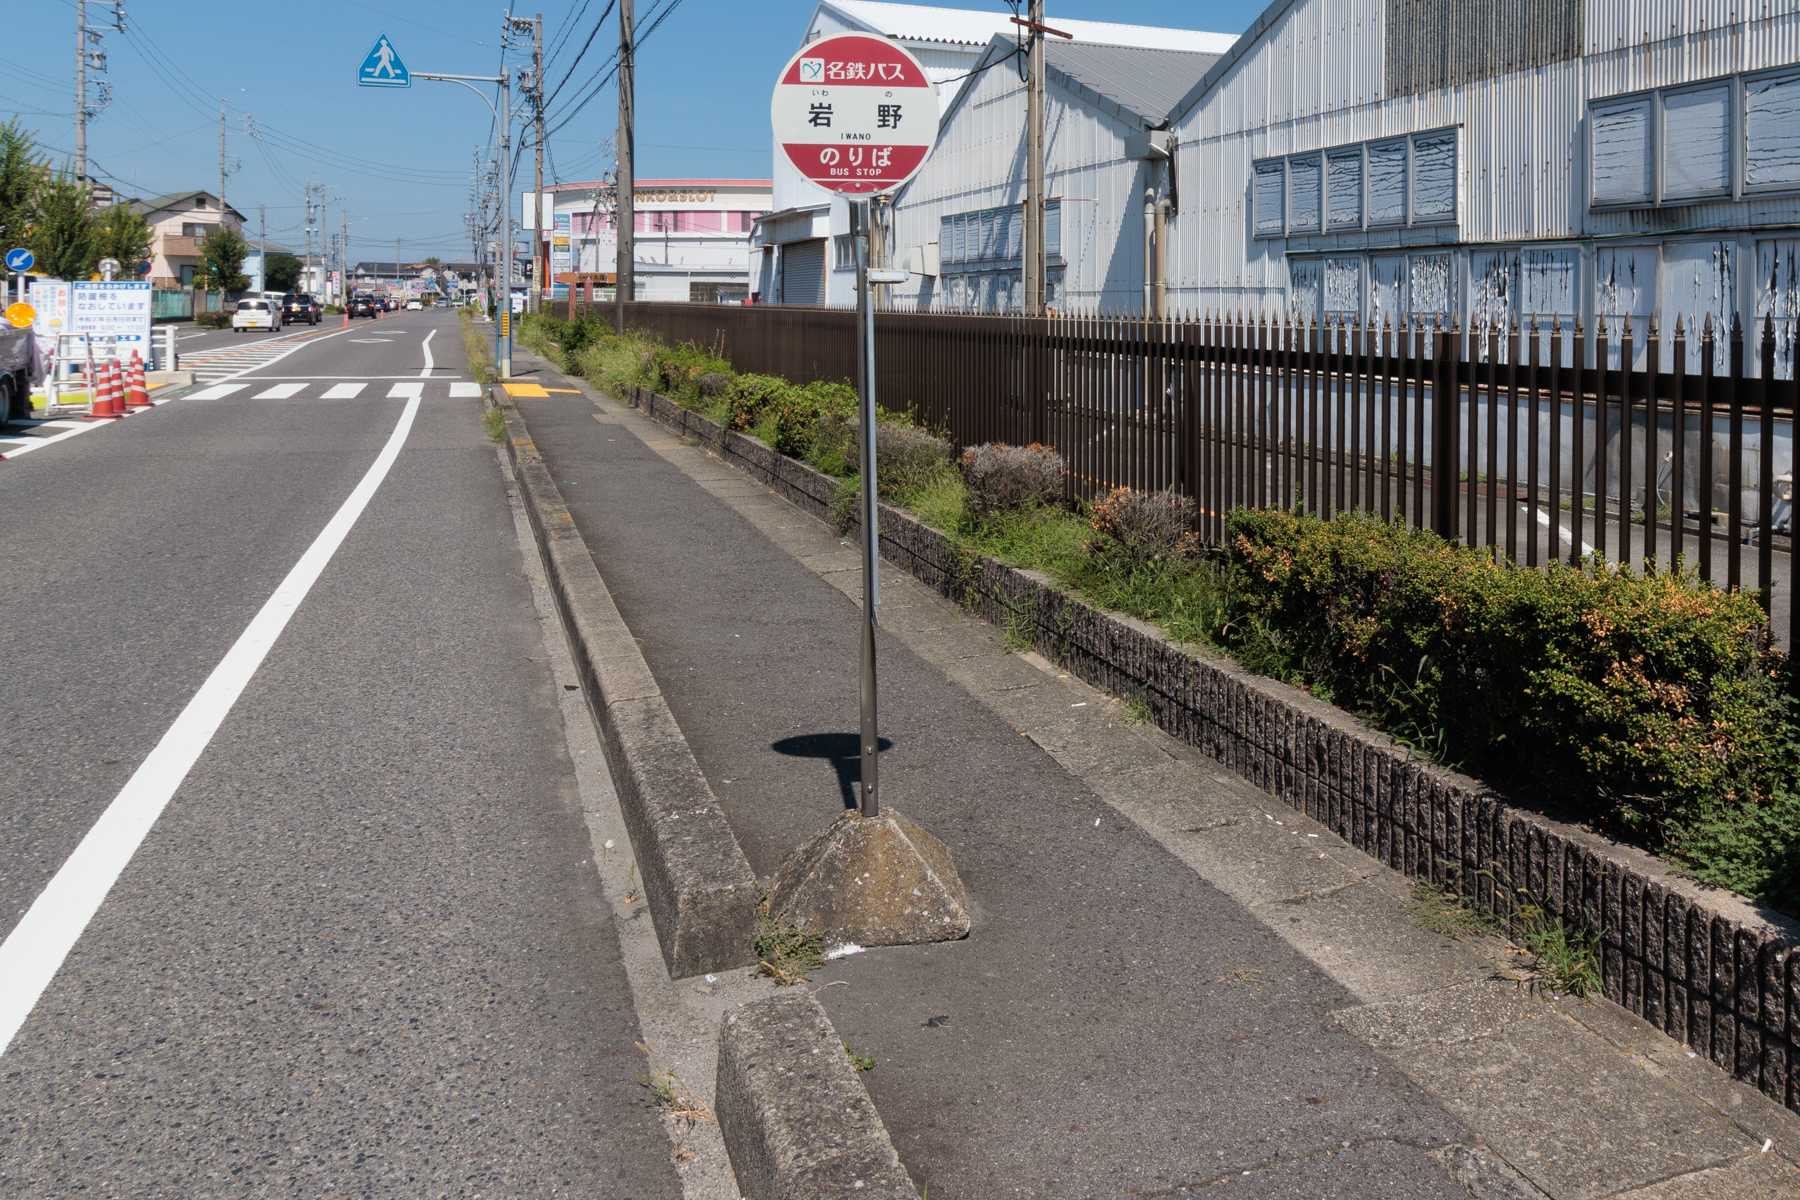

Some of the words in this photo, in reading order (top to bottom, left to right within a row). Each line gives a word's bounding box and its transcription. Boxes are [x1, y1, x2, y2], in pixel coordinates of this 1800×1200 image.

[826, 61, 905, 81] 名鉄バス
[812, 89, 829, 97] いわ
[840, 133, 871, 141] IWANO
[819, 146, 893, 167] のりば
[830, 168, 850, 176] BUS
[856, 168, 882, 176] STOP
[634, 190, 715, 202] NKO&SLOT
[78, 292, 117, 300] 防護柵を
[57, 289, 66, 316] お願い
[78, 302, 145, 310] なおしています
